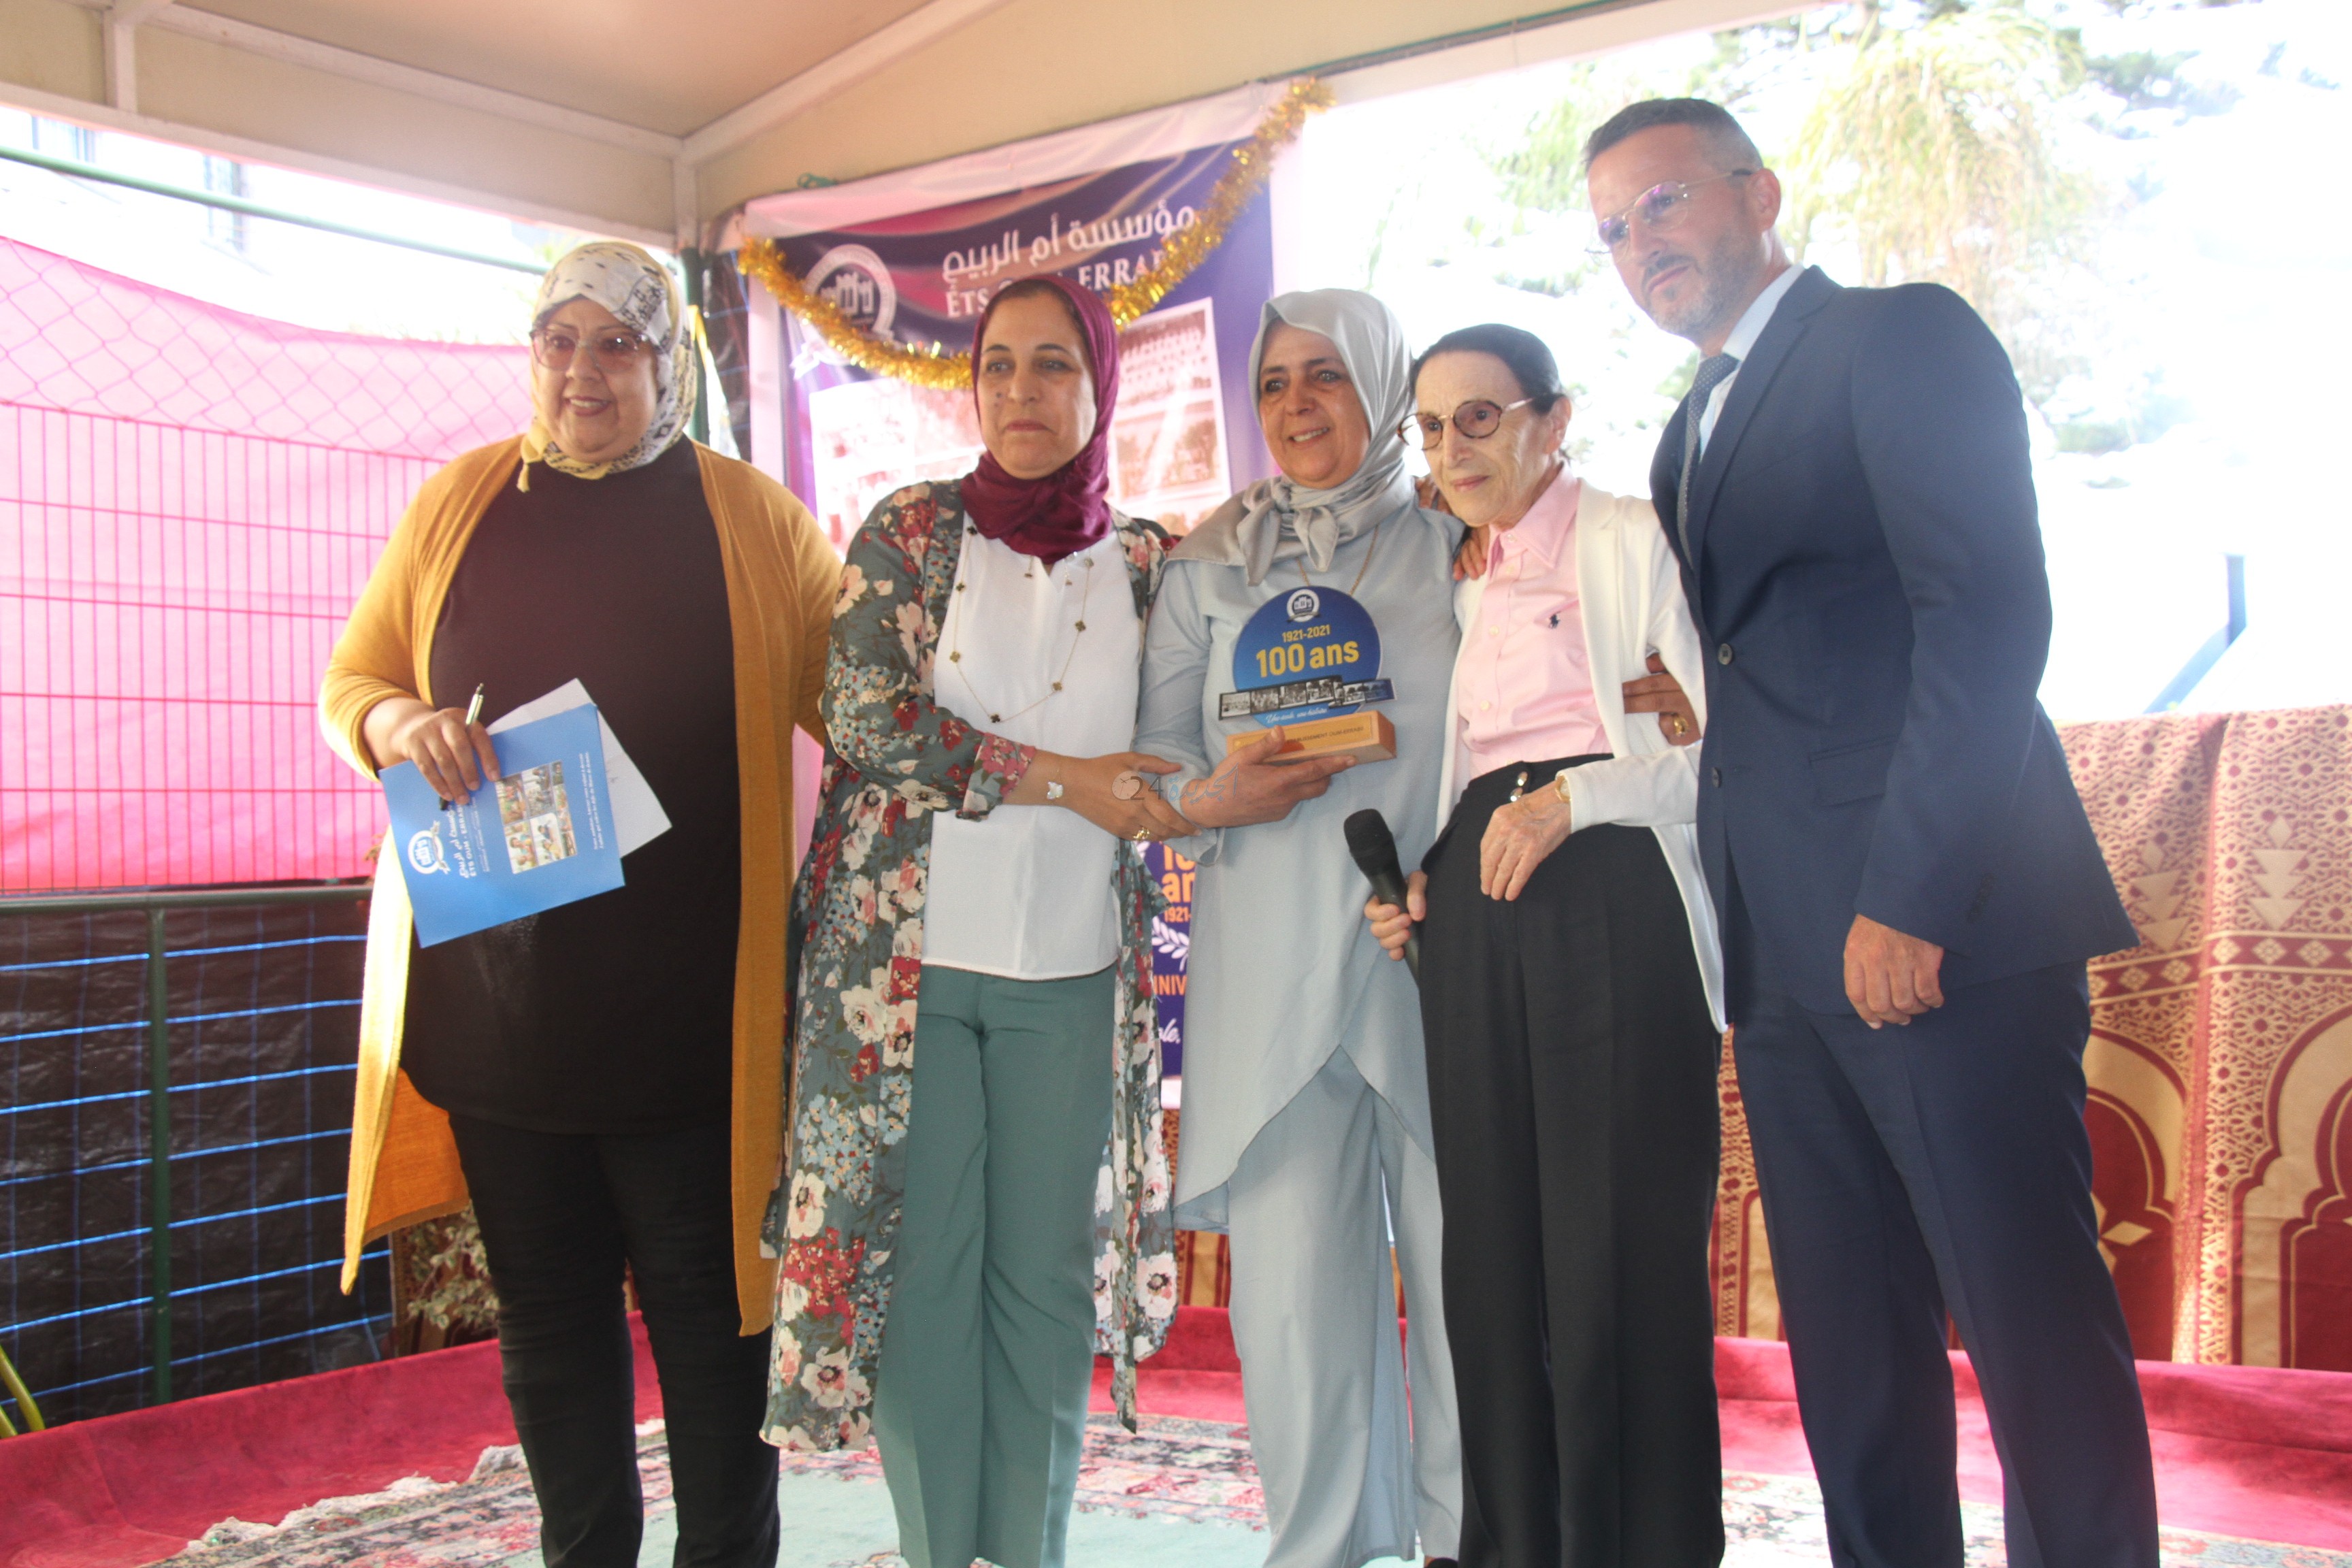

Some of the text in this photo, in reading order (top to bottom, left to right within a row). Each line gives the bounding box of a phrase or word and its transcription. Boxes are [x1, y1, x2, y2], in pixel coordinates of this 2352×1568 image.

[942, 199, 1195, 284] مؤسسة أم الربيع
[1281, 624, 1330, 642] 1921-2021
[1256, 640, 1359, 678] 100 ans
